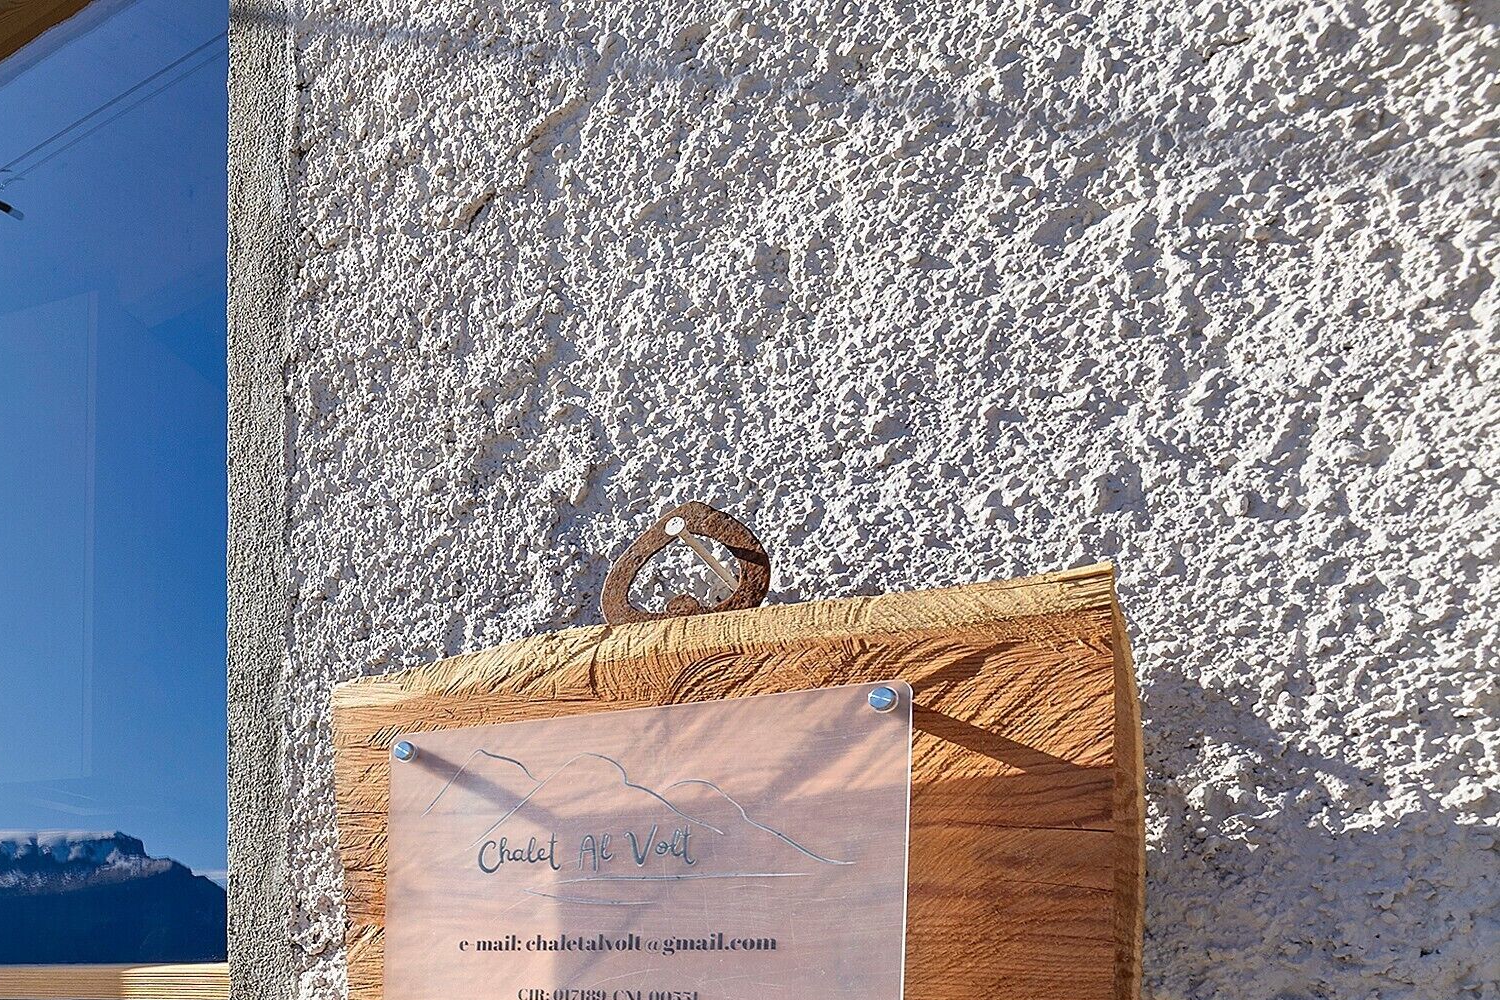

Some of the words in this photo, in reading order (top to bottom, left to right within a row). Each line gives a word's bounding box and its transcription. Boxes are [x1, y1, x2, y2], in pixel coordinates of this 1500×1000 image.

[478, 832, 561, 873] Chalet
[578, 834, 613, 872] Al
[625, 824, 697, 867] Volt
[459, 935, 521, 951] e-mail:
[526, 933, 777, 956] chaletalvolt@gmail.com
